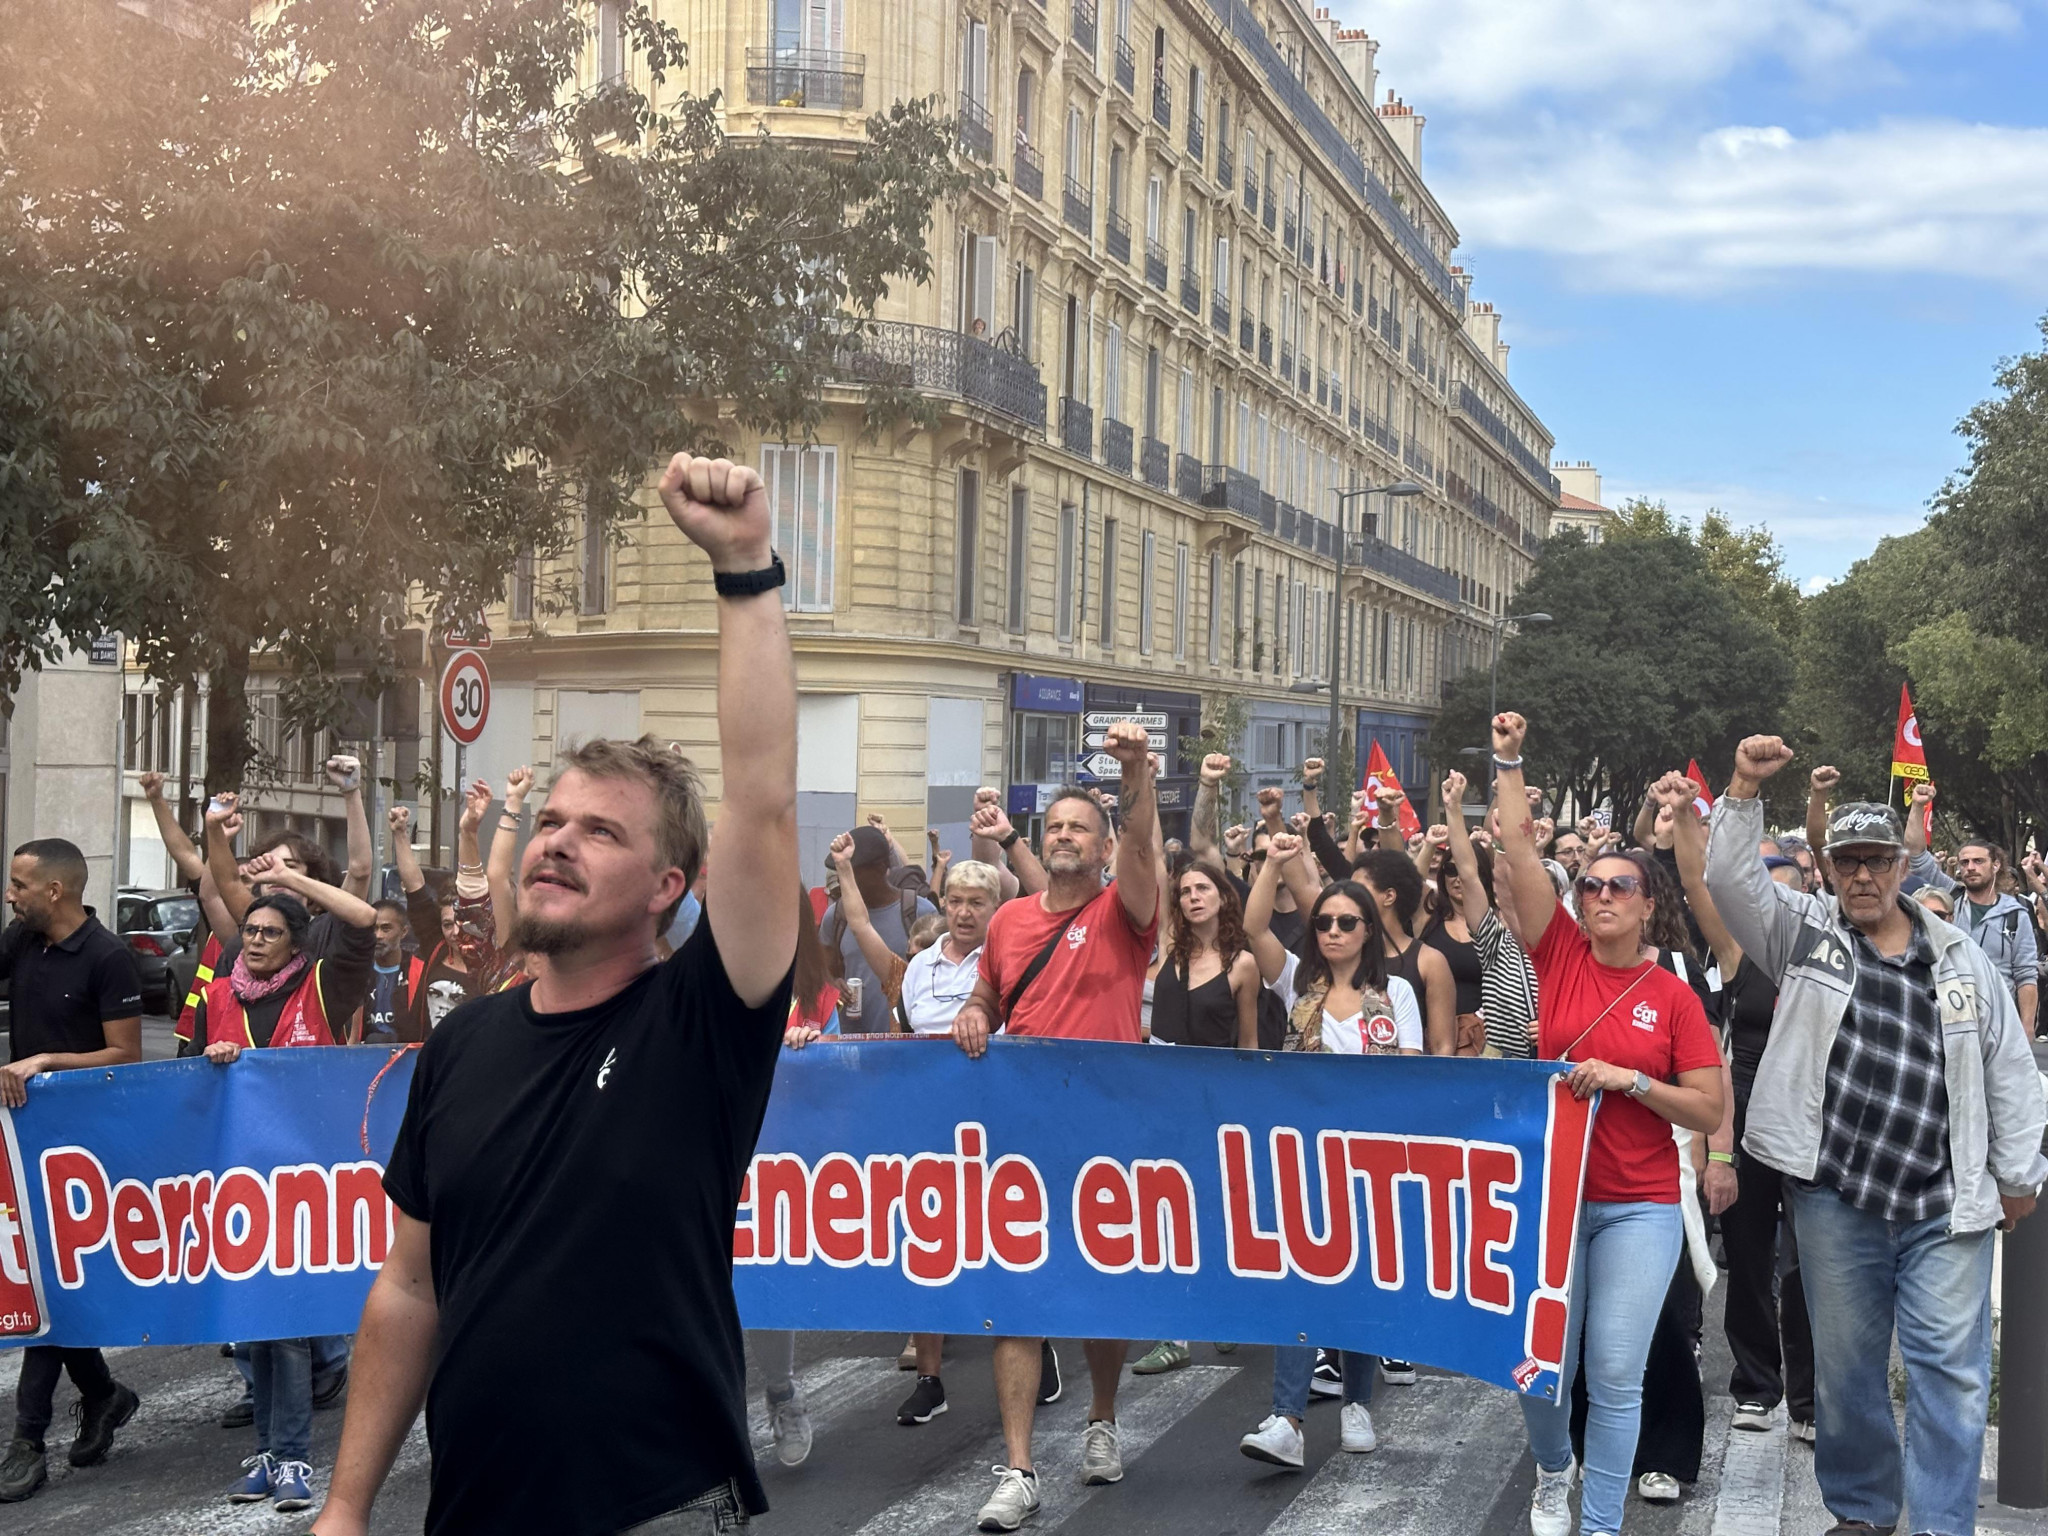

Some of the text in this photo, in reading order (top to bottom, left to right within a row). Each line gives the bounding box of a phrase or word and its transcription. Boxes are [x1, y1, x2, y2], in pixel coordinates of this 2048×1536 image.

[454, 677, 483, 718] 30
[1129, 716, 1164, 725] CARMES
[1833, 808, 1888, 832] Angel
[1632, 1006, 1658, 1024] cgt
[40, 1145, 400, 1289] Personn
[1072, 1156, 1200, 1274] en
[1217, 1123, 1522, 1316] LUTTE
